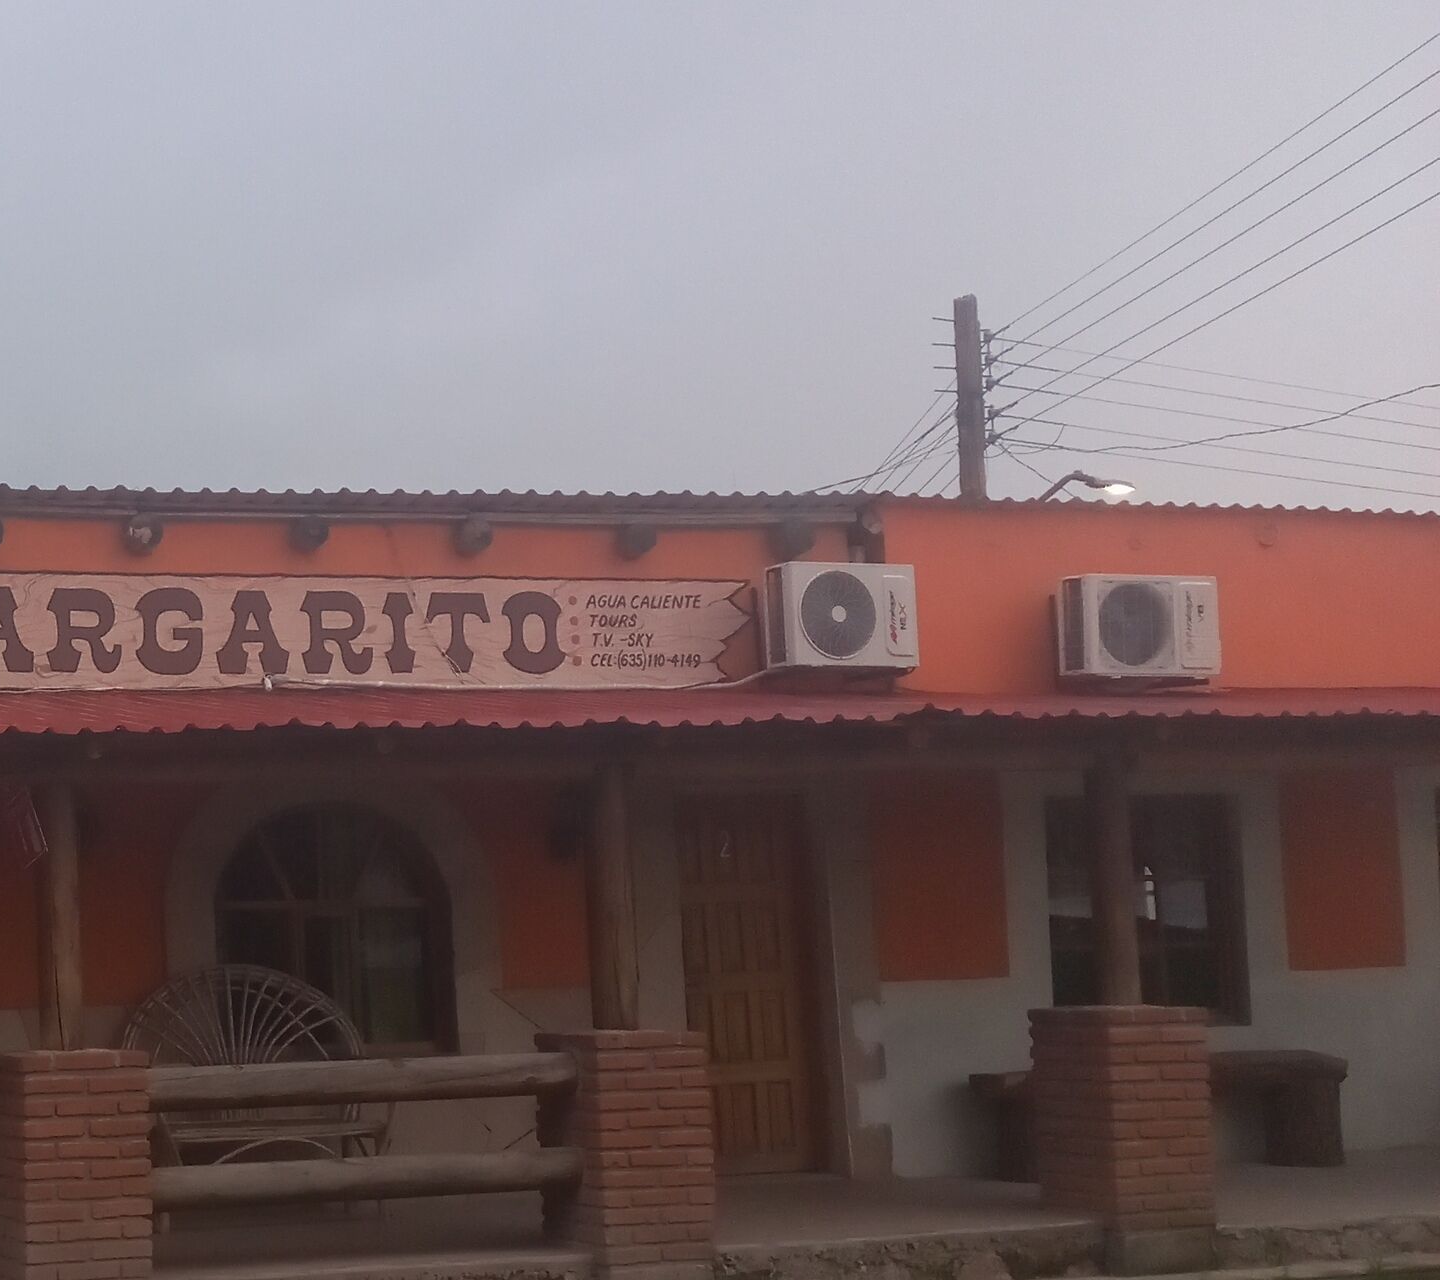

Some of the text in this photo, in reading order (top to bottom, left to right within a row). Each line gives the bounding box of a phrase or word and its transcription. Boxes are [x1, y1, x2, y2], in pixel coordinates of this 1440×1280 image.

[585, 594, 702, 609] AGUA CALIENTE
[589, 613, 638, 628] TOURS
[719, 830, 731, 858] 2
